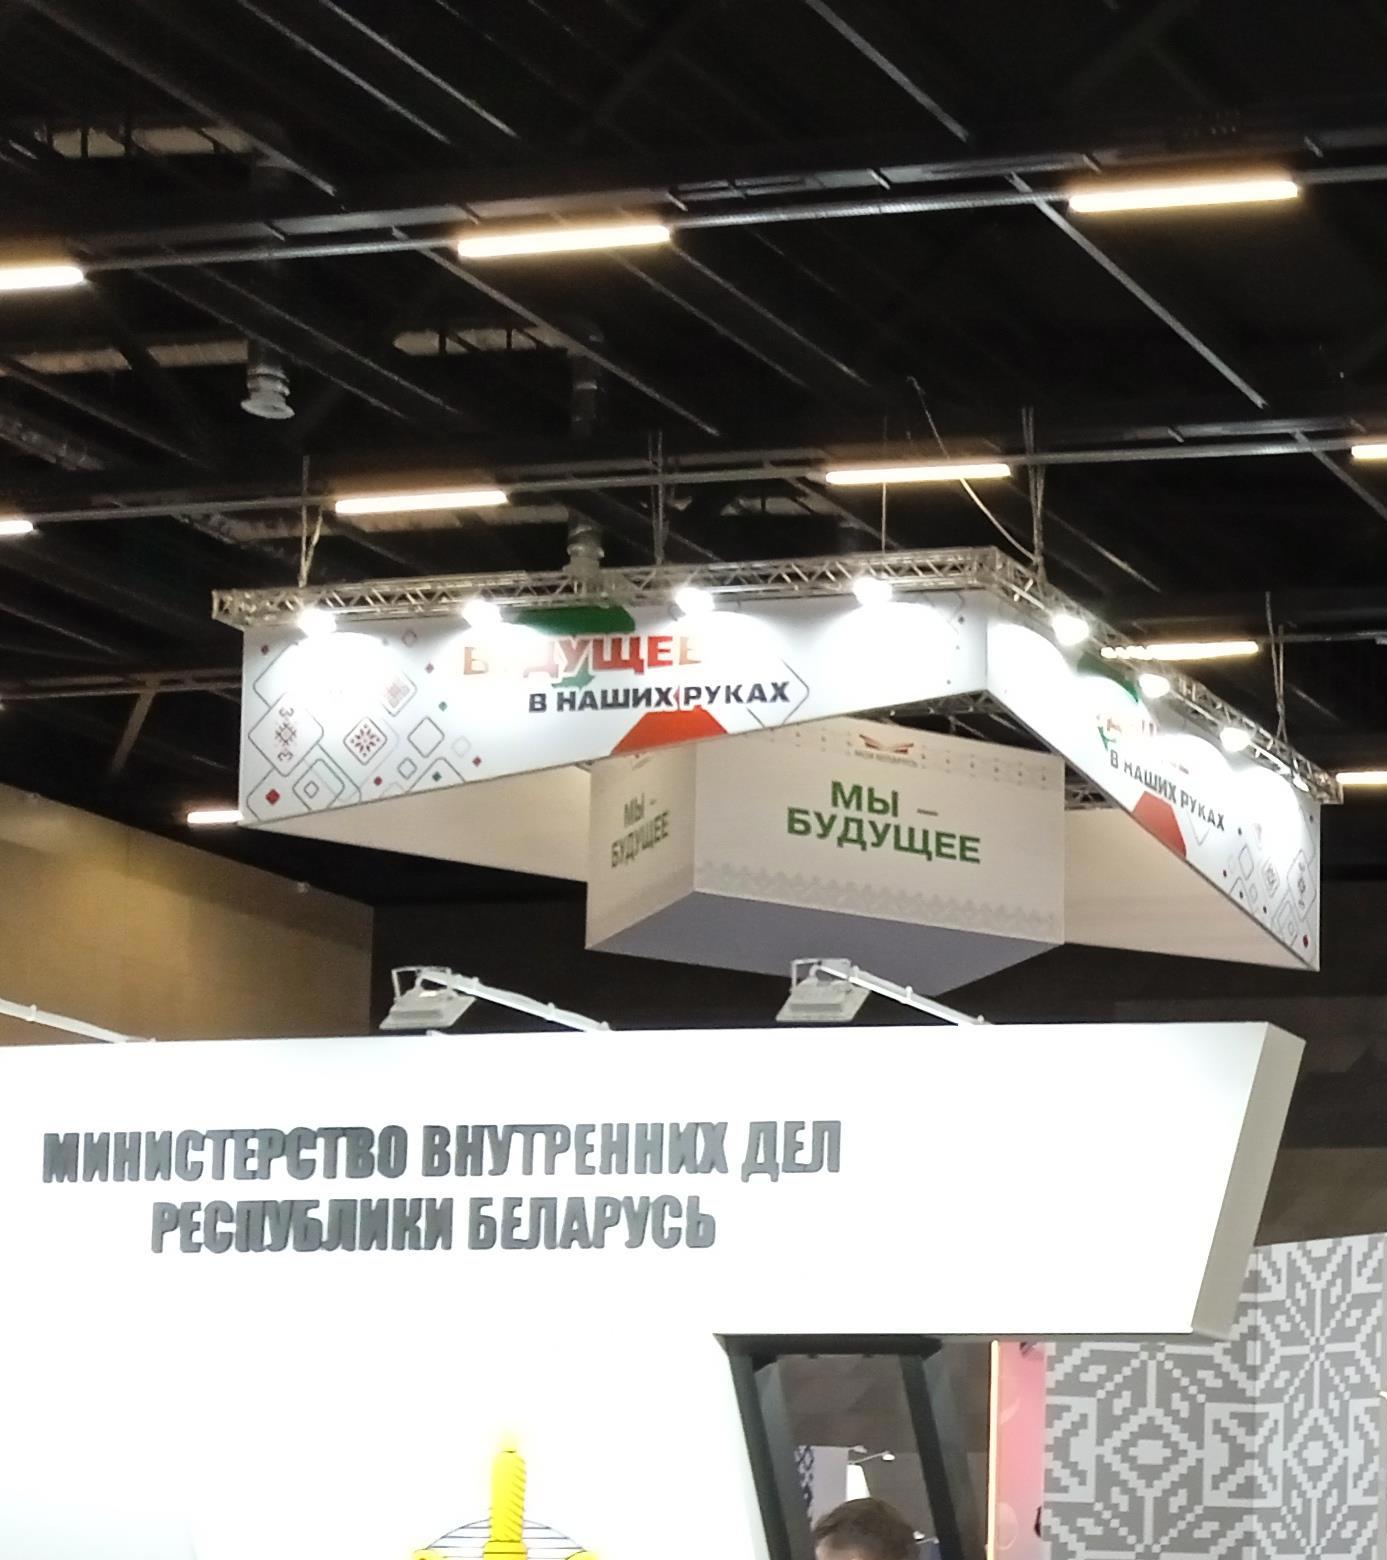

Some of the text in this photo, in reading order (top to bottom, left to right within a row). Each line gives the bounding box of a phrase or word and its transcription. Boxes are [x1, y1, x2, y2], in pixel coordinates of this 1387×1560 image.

[463, 635, 702, 678] БДУЩЕЕ
[529, 681, 790, 713] В НАШИХ РУКАХ
[623, 793, 645, 823] МЫ
[831, 780, 900, 817] МЫ
[1124, 761, 1177, 806] НАШИХ
[1180, 790, 1225, 832] РУКАХ
[610, 810, 670, 868] БУДУЩЕЕ
[786, 806, 982, 864] БУДУЩЕЕ
[43, 1120, 842, 1183] МИНИСТЕРСТВО ВНУТРЕННИХ ДЕЛ
[151, 1195, 717, 1254] РЕСПУБЛИКИ БЕЛАРУСЬ
